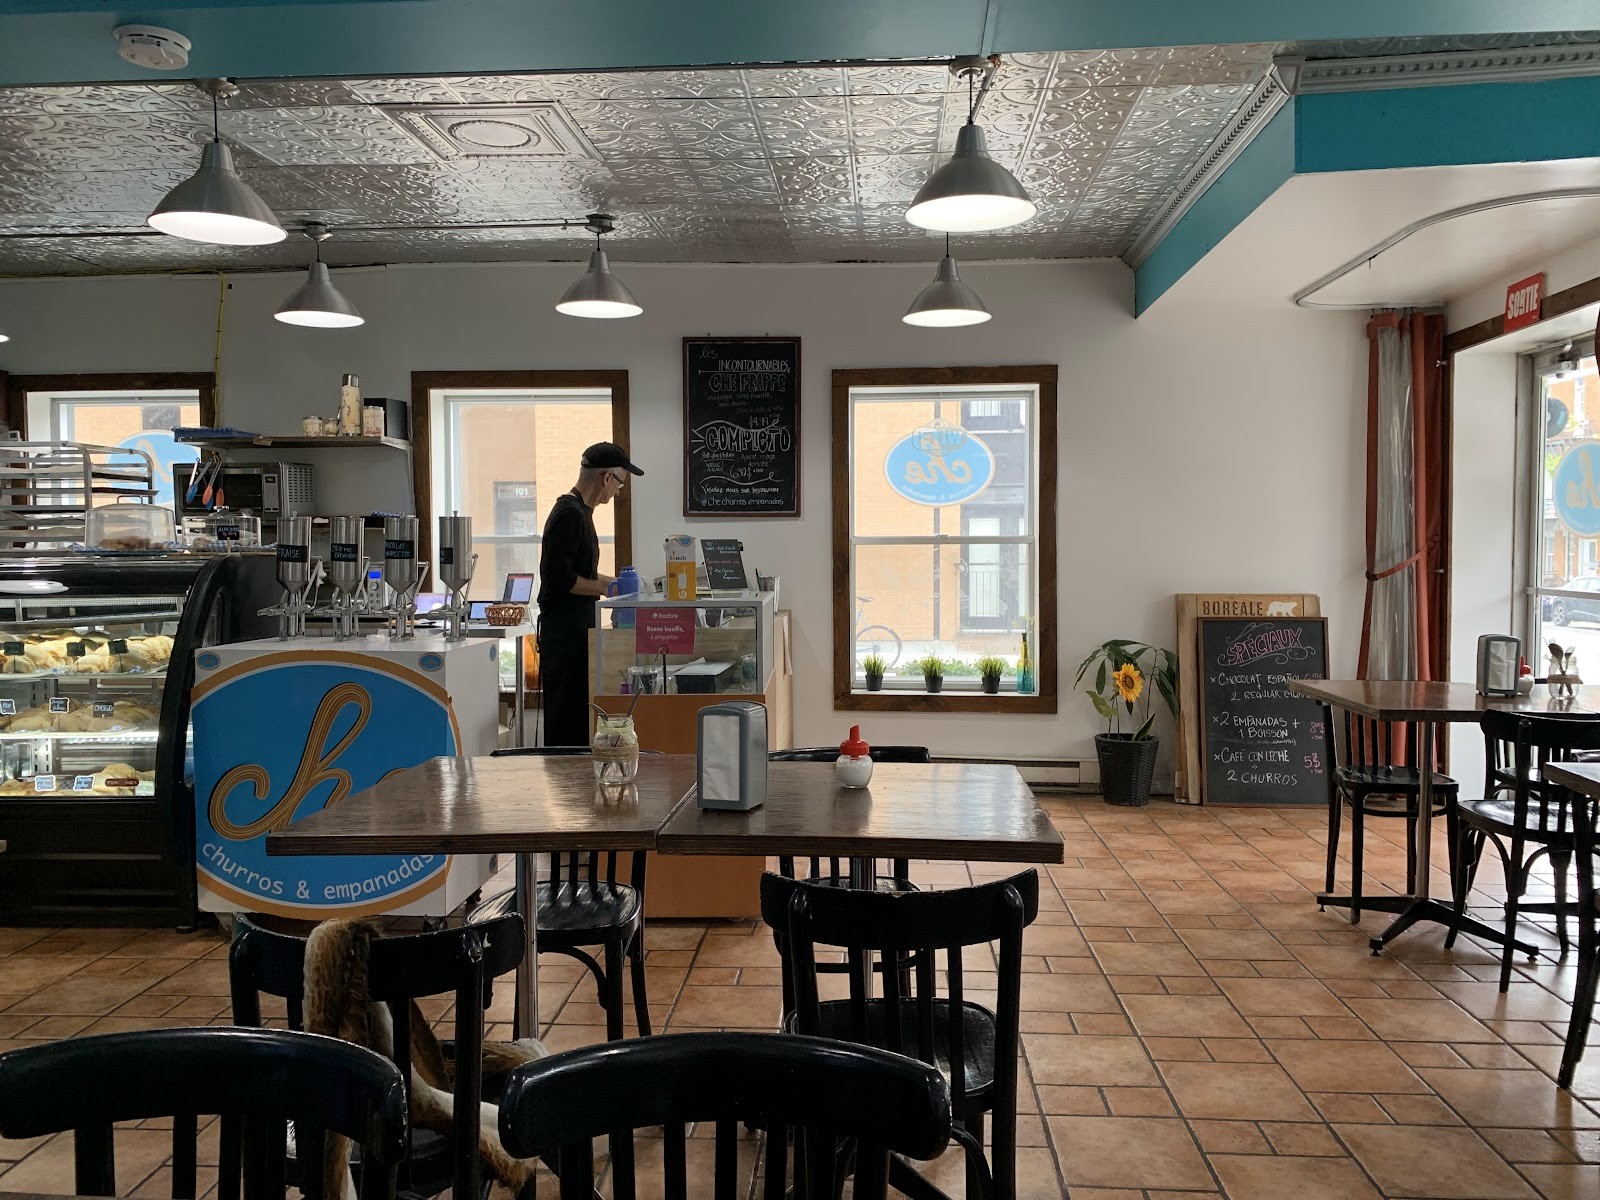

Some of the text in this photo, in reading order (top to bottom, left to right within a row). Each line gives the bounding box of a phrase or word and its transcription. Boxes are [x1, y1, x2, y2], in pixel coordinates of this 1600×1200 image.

[1508, 283, 1539, 319] SORTIE
[705, 426, 790, 453] COMPLETO
[514, 487, 528, 496] 101
[278, 548, 300, 558] FRAISE
[1227, 627, 1302, 665] SPÉCIAUX
[1218, 672, 1262, 686] CHOCOLAT
[1230, 691, 1241, 701] 2
[1219, 711, 1230, 726] 2
[1232, 715, 1288, 728] EMPANADAS
[1247, 726, 1288, 739] BOISSON
[1265, 749, 1290, 762] LECHE
[1227, 769, 1298, 786] 2 CHURROS
[201, 843, 435, 901] churros & empanadas
